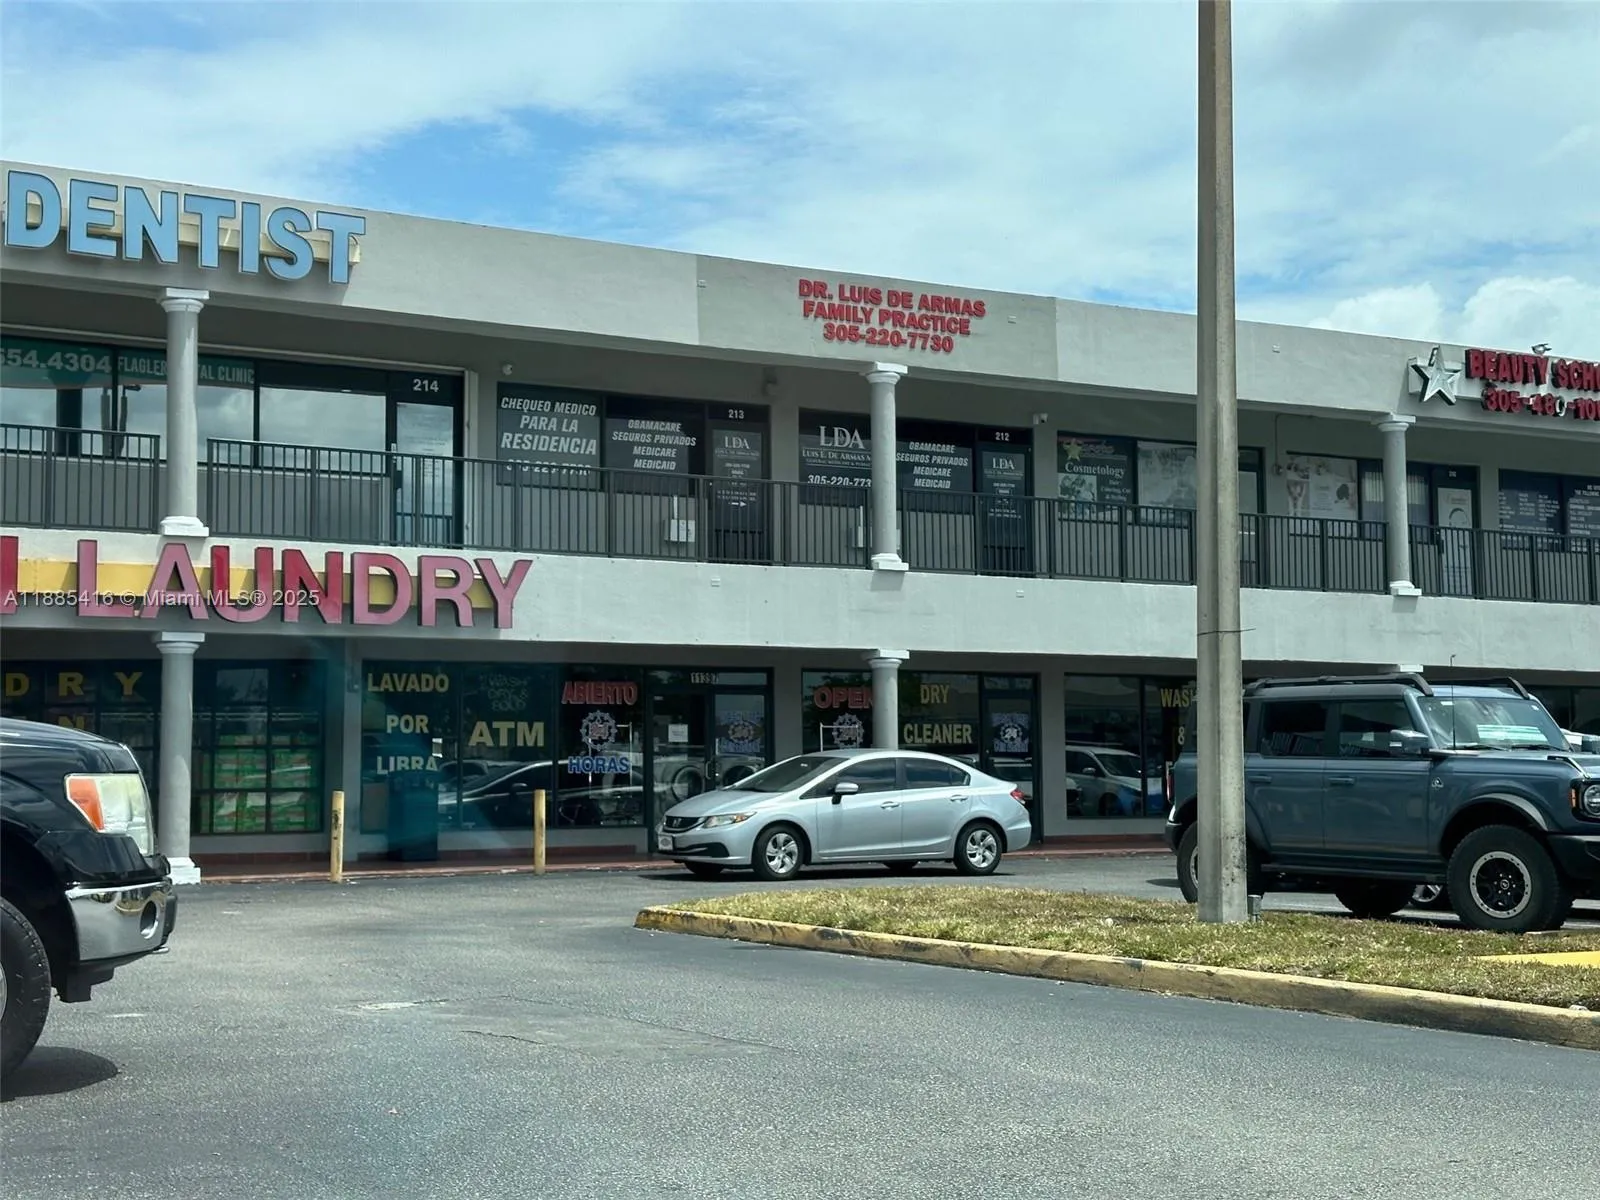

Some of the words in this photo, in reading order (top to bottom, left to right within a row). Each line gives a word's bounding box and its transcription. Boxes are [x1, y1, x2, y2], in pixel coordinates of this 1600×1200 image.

[5, 169, 366, 285] DENTIST
[799, 279, 833, 299] DR.
[838, 283, 882, 306] LUIS
[887, 289, 913, 309] DE
[918, 293, 986, 318] ARMAS
[803, 300, 872, 325] FAMILY
[878, 308, 971, 336] PRACTICE
[823, 322, 954, 353] 305-220-7730
[118, 356, 168, 376] FLAGLER
[218, 366, 255, 384] CLINIC
[1465, 349, 1549, 386] BEAUTY
[413, 378, 440, 392] 214
[501, 397, 551, 413] CHEQUEO
[554, 401, 597, 416] MEDICO
[728, 409, 744, 419] 213
[520, 415, 557, 431] PARA
[561, 418, 578, 433] LA
[628, 419, 682, 432] OBAMACARE
[501, 432, 597, 455] RESIDENCIA
[612, 431, 651, 444] SEGUROS
[654, 434, 697, 446] PRIVADOS
[725, 435, 750, 449] LDA
[819, 425, 866, 449] LDA
[995, 432, 1010, 441] 212
[633, 446, 677, 458] MEDICARE
[909, 441, 955, 454] OBAMACARE
[634, 458, 676, 471] MEDICAID
[896, 454, 929, 464] SEGUROS
[931, 457, 968, 467] PRIVADOS
[992, 457, 1015, 470] LDA
[913, 465, 951, 477] MEDICARE
[1065, 461, 1125, 479] Cosmetology
[808, 474, 872, 487] 305-220-773
[914, 477, 951, 489] MEDICAID
[78, 538, 533, 629] LAUNDRY
[367, 673, 449, 693] LAVADO
[561, 681, 638, 705] ABIERTO
[920, 684, 949, 704] DRY
[1160, 687, 1192, 708] WAS
[386, 714, 429, 734] POR
[468, 721, 544, 747] ATM
[903, 723, 972, 744] CLEANER
[567, 756, 631, 774] HORAS
